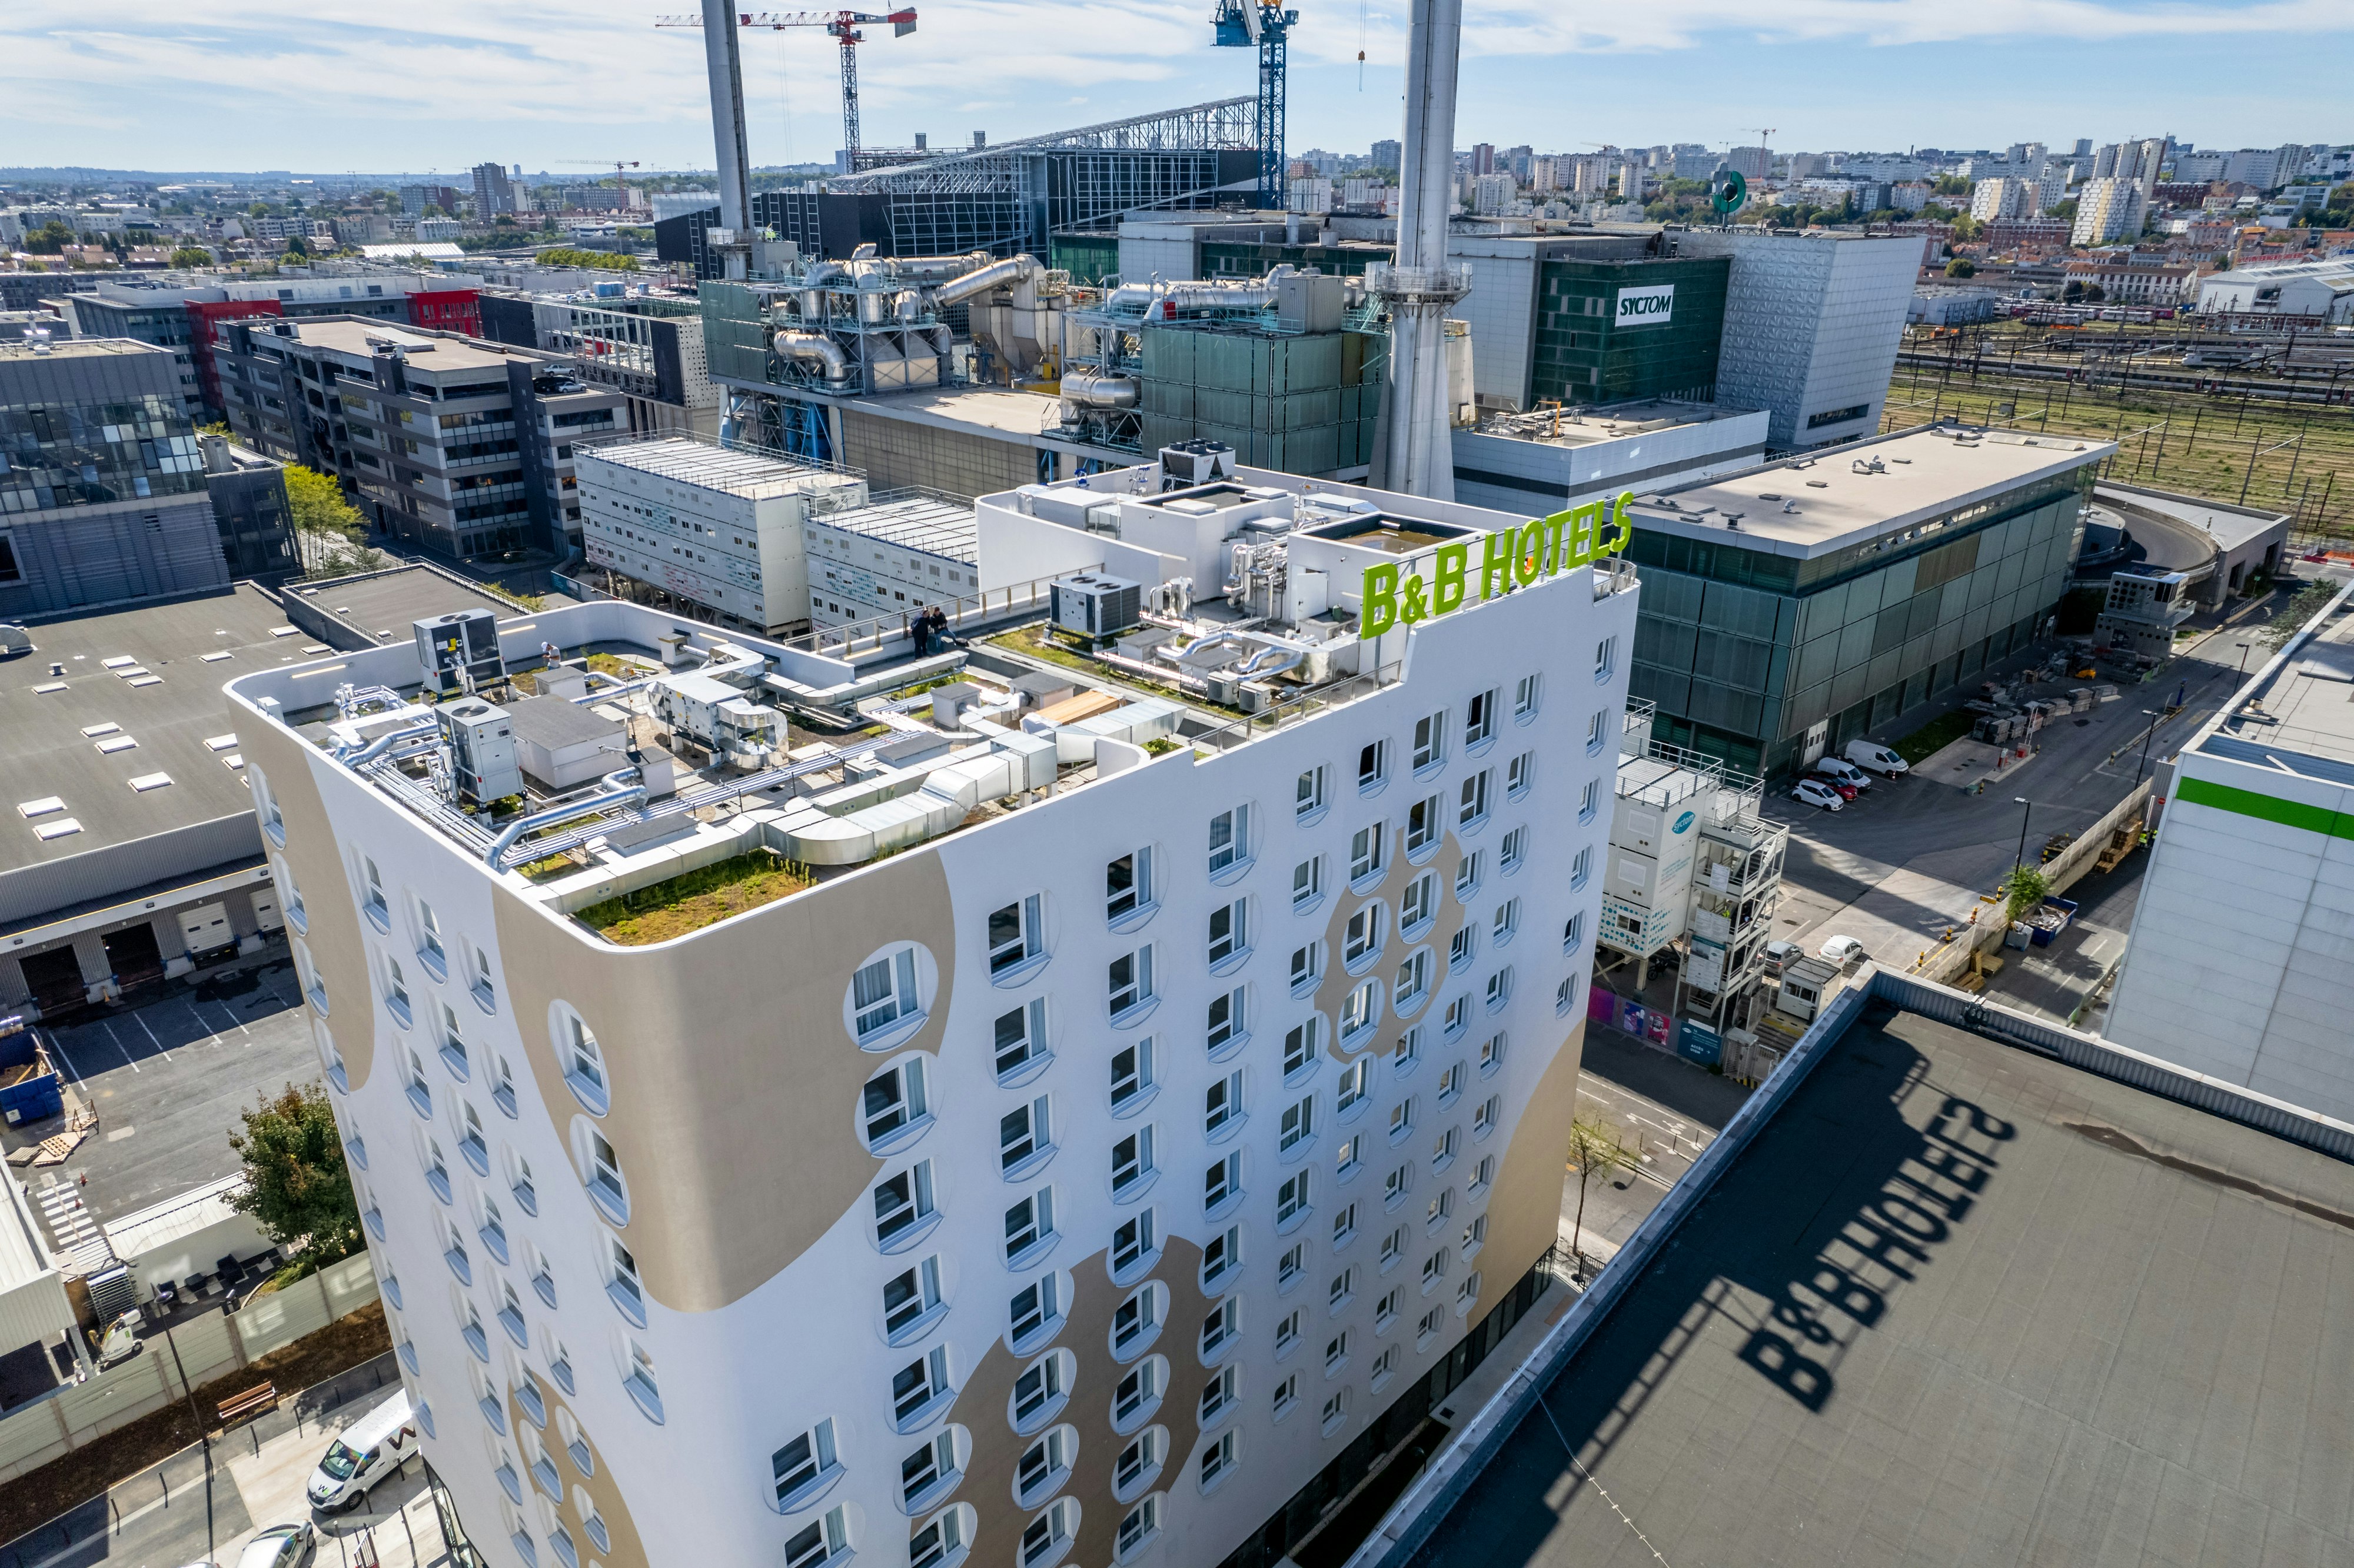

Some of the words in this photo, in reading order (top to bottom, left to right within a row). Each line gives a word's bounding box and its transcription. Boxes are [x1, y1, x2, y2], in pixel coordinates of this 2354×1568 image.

[1620, 295, 1671, 316] SYCTOM
[1361, 543, 1468, 640] B&B
[1480, 491, 1634, 600] HOTELS
[1673, 814, 1694, 832] syctom
